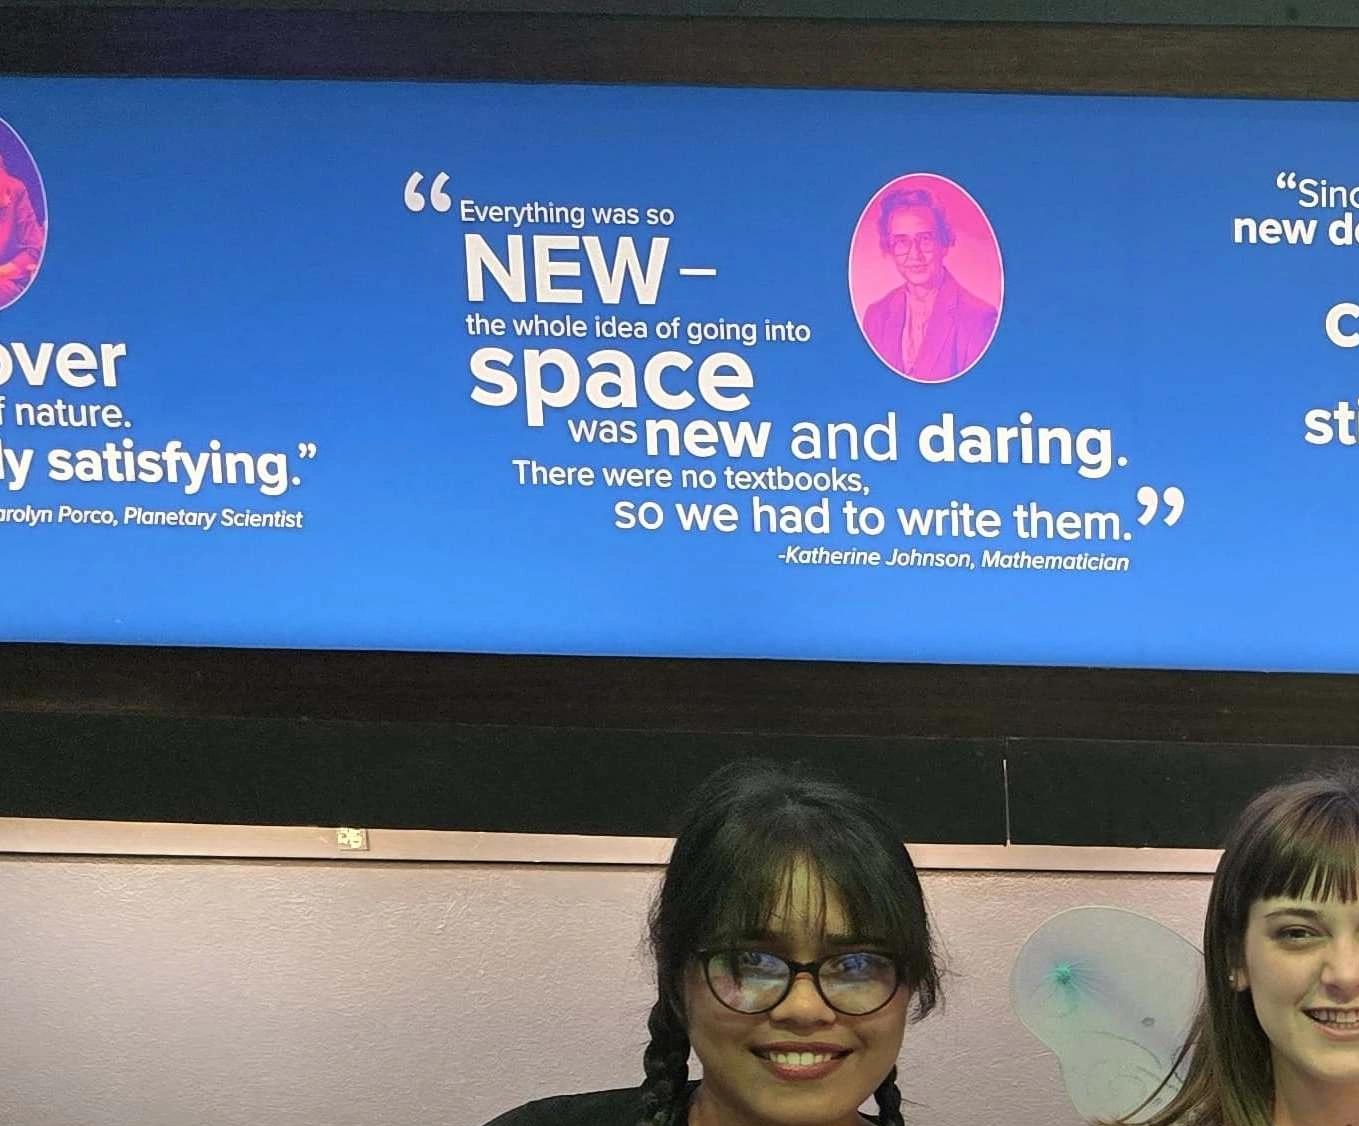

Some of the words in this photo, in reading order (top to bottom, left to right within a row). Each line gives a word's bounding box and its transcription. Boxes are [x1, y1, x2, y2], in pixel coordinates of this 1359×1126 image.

[591, 207, 640, 225] was
[646, 208, 675, 226] so
[1234, 218, 1318, 245] new
[465, 313, 506, 336] the
[512, 314, 588, 337] whole
[595, 316, 648, 339] idea
[655, 317, 681, 339] of
[687, 322, 757, 346] going
[765, 321, 811, 342] into
[0, 342, 127, 388] ver
[470, 347, 754, 427] space
[15, 399, 131, 428] nature.
[567, 419, 638, 444] was
[645, 419, 772, 458] new
[791, 411, 897, 462] and
[918, 412, 1128, 479] daring.
[47, 437, 317, 496] satisfying.”
[512, 459, 595, 486] There
[602, 467, 673, 488] were
[681, 469, 717, 489] no
[723, 466, 870, 496] textbooks,
[58, 505, 119, 527] Porco,
[123, 506, 217, 530] Planetary
[220, 508, 304, 528] Scientist
[614, 501, 664, 530] so
[675, 503, 739, 532] we
[752, 495, 830, 534] had
[842, 500, 885, 536] to
[897, 500, 1002, 538] write
[778, 546, 881, 566] -Katherine
[885, 548, 975, 570] Johnson,
[981, 549, 1130, 571] Mathematician
